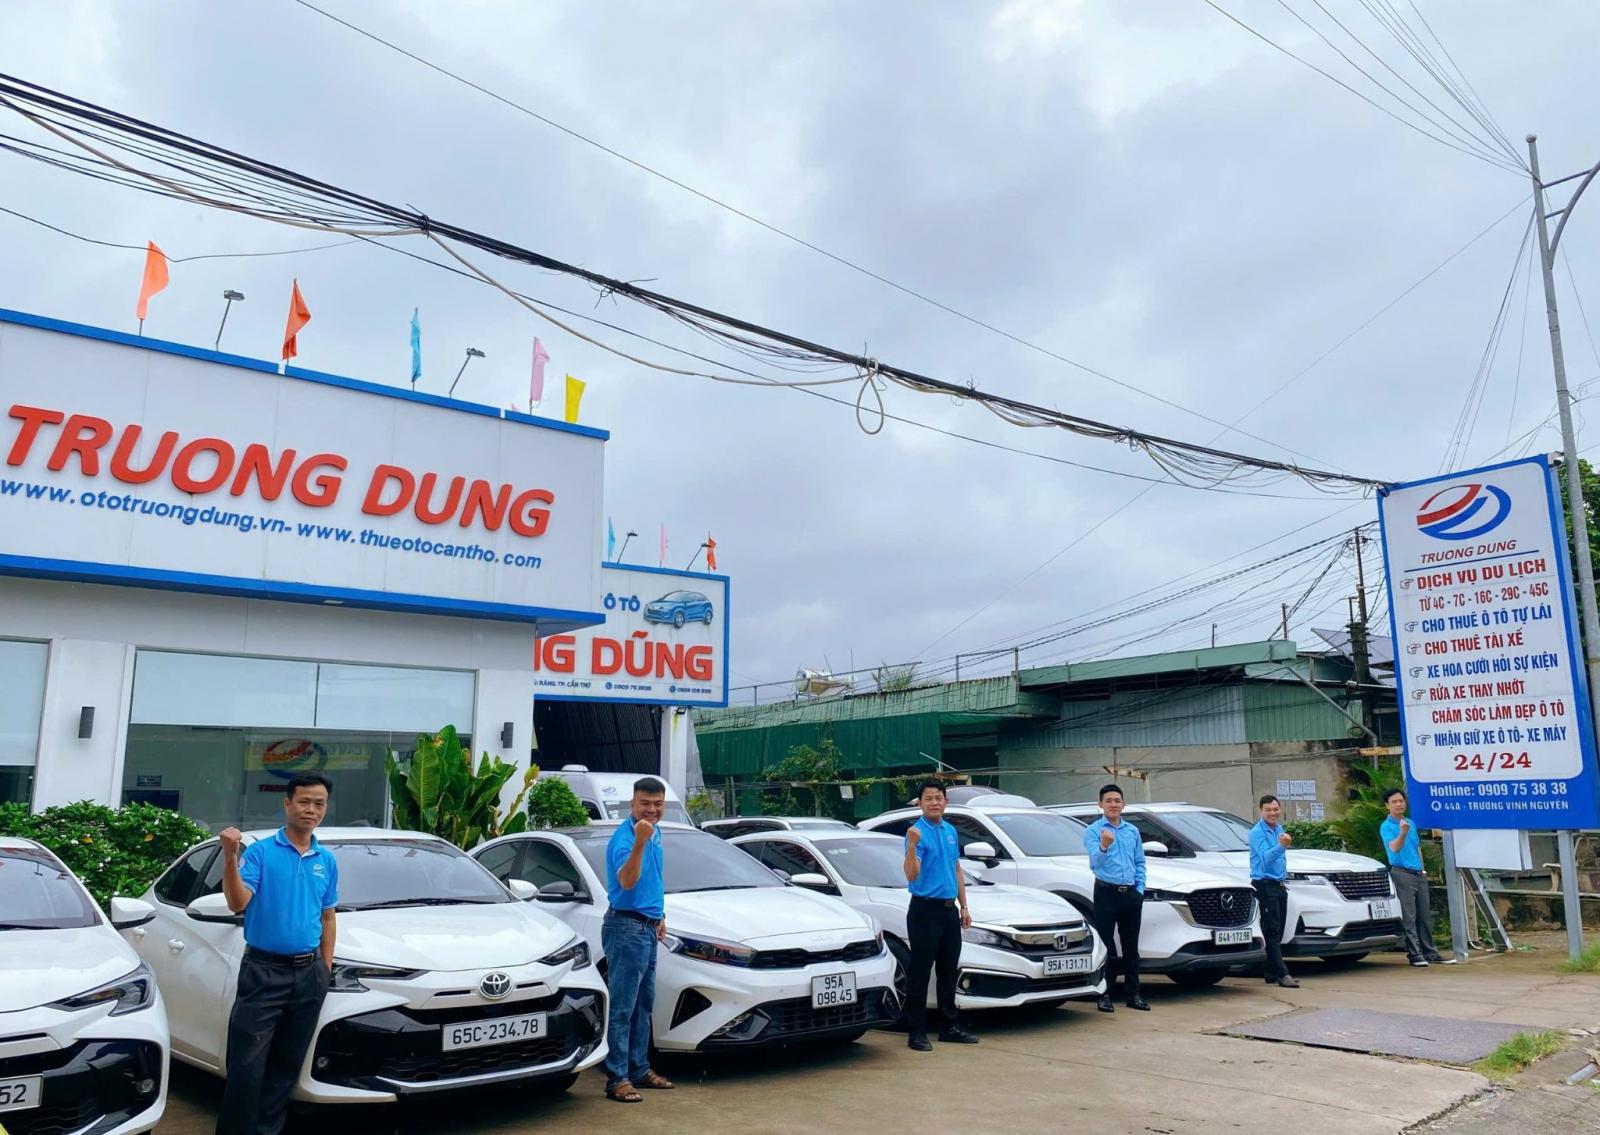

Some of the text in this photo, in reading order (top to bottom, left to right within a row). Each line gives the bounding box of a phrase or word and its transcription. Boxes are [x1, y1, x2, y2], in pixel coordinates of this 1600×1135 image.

[7, 404, 555, 538] TRUONG DUNG
[1420, 539, 1517, 564] TRUONG DUNG
[1417, 558, 1546, 591] DỊCH VỤ DU LỊCH
[604, 592, 641, 612] Ô TÔ
[1420, 595, 1430, 612] TỪ
[1433, 597, 1445, 611] 4C
[1453, 593, 1465, 607] 7C
[1474, 590, 1492, 604] 16C
[1501, 586, 1520, 601] 29C
[1529, 582, 1549, 597] 45C
[1422, 604, 1552, 633] CHO THUÊ Ô TÔ TỰ LÁI
[1424, 627, 1524, 655] CHO THUÊ TÀI XẾ
[534, 630, 713, 681] G DŨNG
[1427, 651, 1559, 679] XE HOA CƯỚI HỎI SỰ KIỆN
[1429, 678, 1525, 701] RỬA XE THAY NHỚT
[1432, 699, 1565, 724] CHĂM SÓC LÀM ĐẸP Ô TÔ
[1434, 730, 1461, 749] NHẬN
[1463, 729, 1480, 746] GIỮ
[1483, 730, 1496, 745] XE
[1499, 726, 1505, 743] Ô
[1527, 727, 1541, 742] XE
[1543, 723, 1567, 741] MÁY
[1453, 752, 1532, 773] 24/24
[1430, 781, 1567, 797] Hotline: 0909 75 38 38
[1444, 802, 1461, 811] 44A
[824, 975, 844, 990] 95A
[817, 988, 852, 1006] 098.45
[0, 1083, 27, 1106] 52
